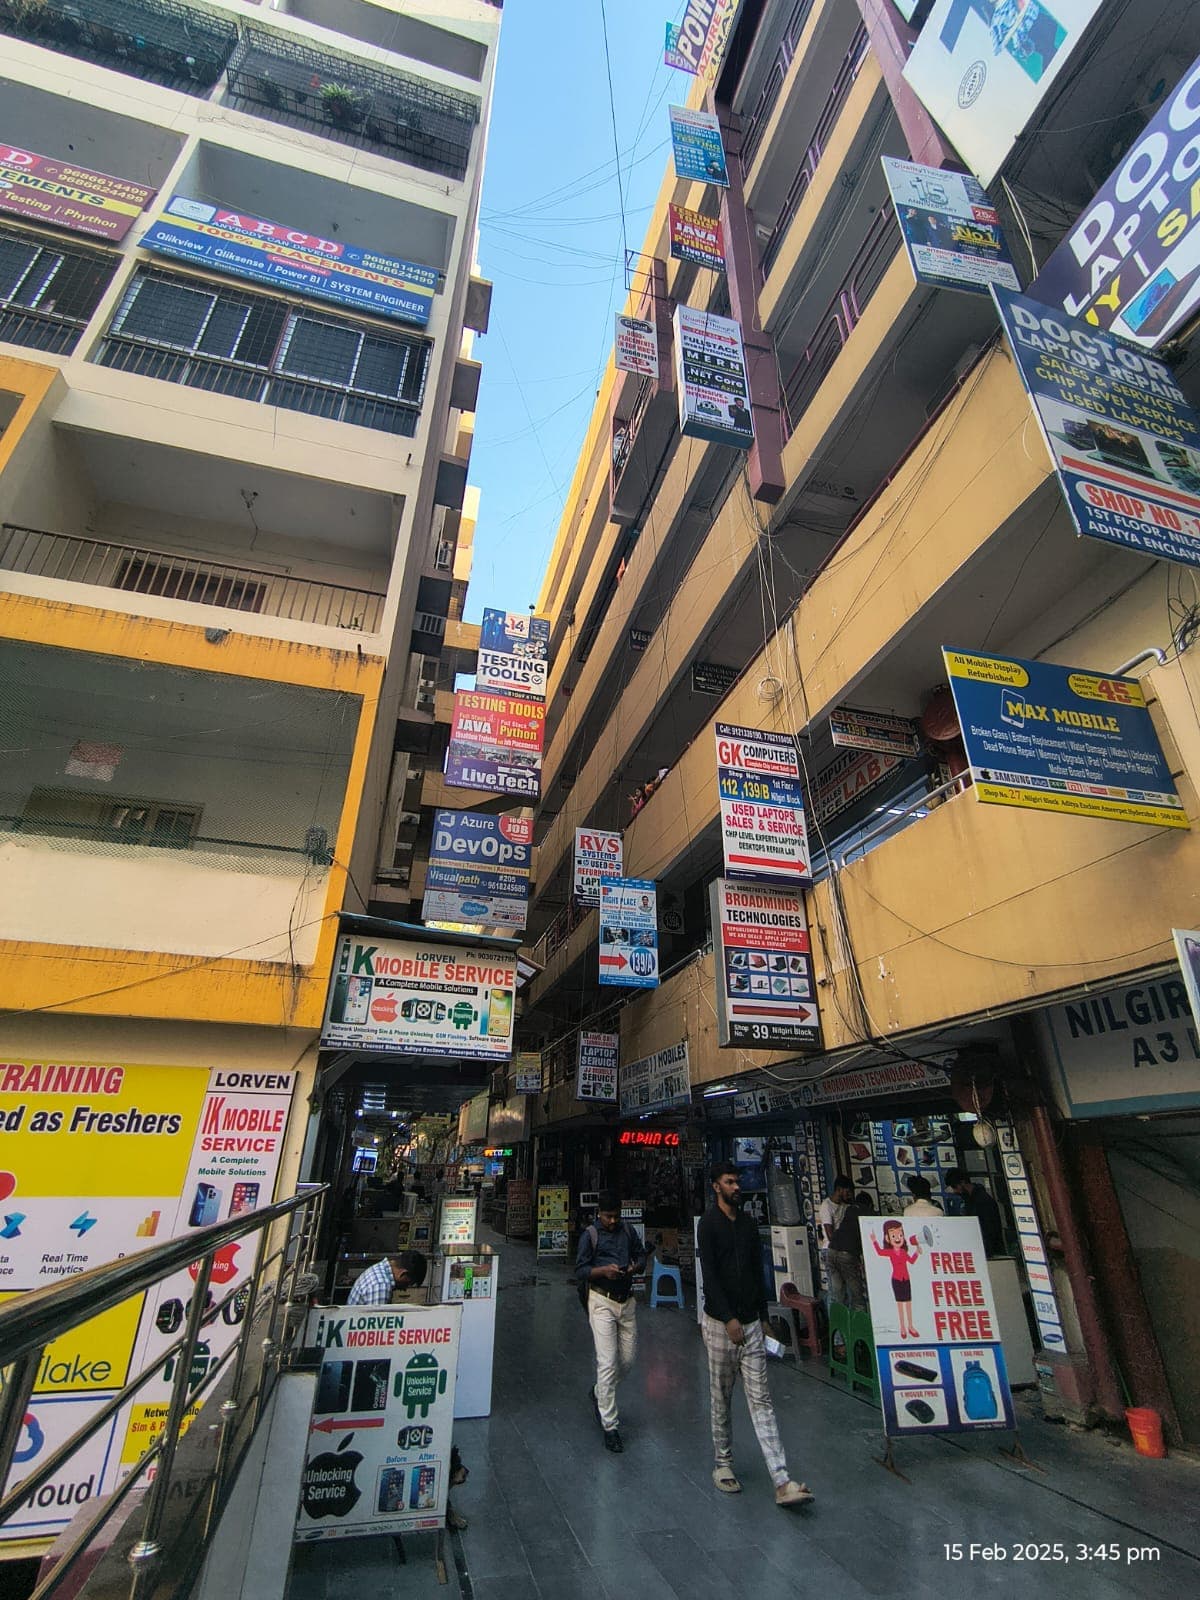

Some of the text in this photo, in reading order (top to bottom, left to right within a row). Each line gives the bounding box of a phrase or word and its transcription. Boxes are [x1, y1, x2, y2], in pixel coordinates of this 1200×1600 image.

[5, 190, 118, 230] Testing Phython
[212, 221, 341, 261] ANYBODY CAN DEVELOP
[196, 224, 406, 289] 100% PLACEMENTS
[363, 253, 436, 279] 9686614499
[156, 232, 425, 314] Qlikview Qliksense Power BI SYSTEM ENGINEER
[361, 259, 434, 286] 9686624499
[684, 335, 739, 355] FULLSTACK
[1010, 303, 1173, 385] DOCTOR
[1014, 326, 1101, 370] LAPTOP
[1106, 362, 1188, 404] REPAIR
[714, 371, 743, 388] Core
[1040, 354, 1176, 414] SALES & SERVICE
[1035, 366, 1198, 434] CHIP LEVEL SERVICE
[1060, 389, 1185, 442] USED LAPTOPS
[1085, 484, 1145, 519] SHOP
[1085, 506, 1109, 521] 1ST
[1088, 520, 1141, 545] ADITYA
[482, 653, 544, 673] TESTING
[954, 655, 1022, 676] All Mobile Display
[480, 665, 530, 682] TOOLS
[967, 669, 1015, 683] Refurbished
[1097, 679, 1132, 704] 45
[458, 693, 506, 713] TESTING
[509, 701, 544, 720] TOOLS
[1006, 700, 1120, 733] MAX MOBILE
[457, 718, 537, 740] JAVA Python
[970, 725, 992, 737] Broken
[992, 728, 1009, 739] Glass
[718, 741, 796, 767] GK COMPUTERS
[462, 768, 539, 791] LiveTech
[721, 778, 738, 796] 112
[842, 757, 881, 800] LAB
[993, 771, 1030, 784] SAMSUNG
[983, 788, 1021, 800] Shop 27
[460, 816, 494, 829] Azure
[731, 803, 796, 823] USED LAPTOPS
[506, 824, 529, 834] JOB
[726, 816, 804, 836] SALES & SERVICE
[435, 831, 526, 863] DevOps
[580, 834, 619, 854] RVS
[725, 830, 801, 846] CHIP LEVEL EXPERTS LAPTOPS
[739, 842, 765, 853] DESKTOPS
[582, 849, 617, 860] SYSTEMS
[590, 861, 607, 869] USED
[430, 870, 480, 885] Visualpath
[725, 892, 799, 912] BROADMINDS
[726, 909, 801, 928] TECHNOLOGIES
[416, 952, 456, 964] LORVEN
[375, 956, 514, 986] MOBILE SERVICE
[385, 980, 418, 989] Complete
[444, 984, 474, 993] Solutions
[734, 1024, 793, 1040] Shop 39 Nilgiri
[582, 1056, 616, 1067] SERVICE
[583, 1047, 616, 1057] LAPTOP
[657, 1044, 686, 1068] MOBILES
[215, 1073, 290, 1089] LORVEN
[582, 1073, 615, 1083] SERVICE
[865, 1064, 925, 1086] TECHNOLOGIES
[30, 1106, 182, 1134] as Freshers
[223, 1109, 284, 1132] MOBILE
[201, 1137, 276, 1152] SERVICE
[219, 1157, 259, 1165] Complete
[198, 1167, 266, 1177] Mobile Solutions
[41, 1254, 88, 1263] Real Time
[930, 1252, 976, 1274] FREE
[39, 1265, 84, 1275] Analytics
[931, 1280, 985, 1306] FREE
[349, 1316, 404, 1330] LORVEN
[934, 1310, 994, 1341] FREE
[346, 1328, 451, 1347] MOBILE SERVICE
[406, 1376, 436, 1387] Unlocking
[408, 1387, 432, 1396] Service
[386, 1456, 408, 1464] Before
[307, 1468, 351, 1483] Unlocking
[307, 1486, 347, 1500] Service
